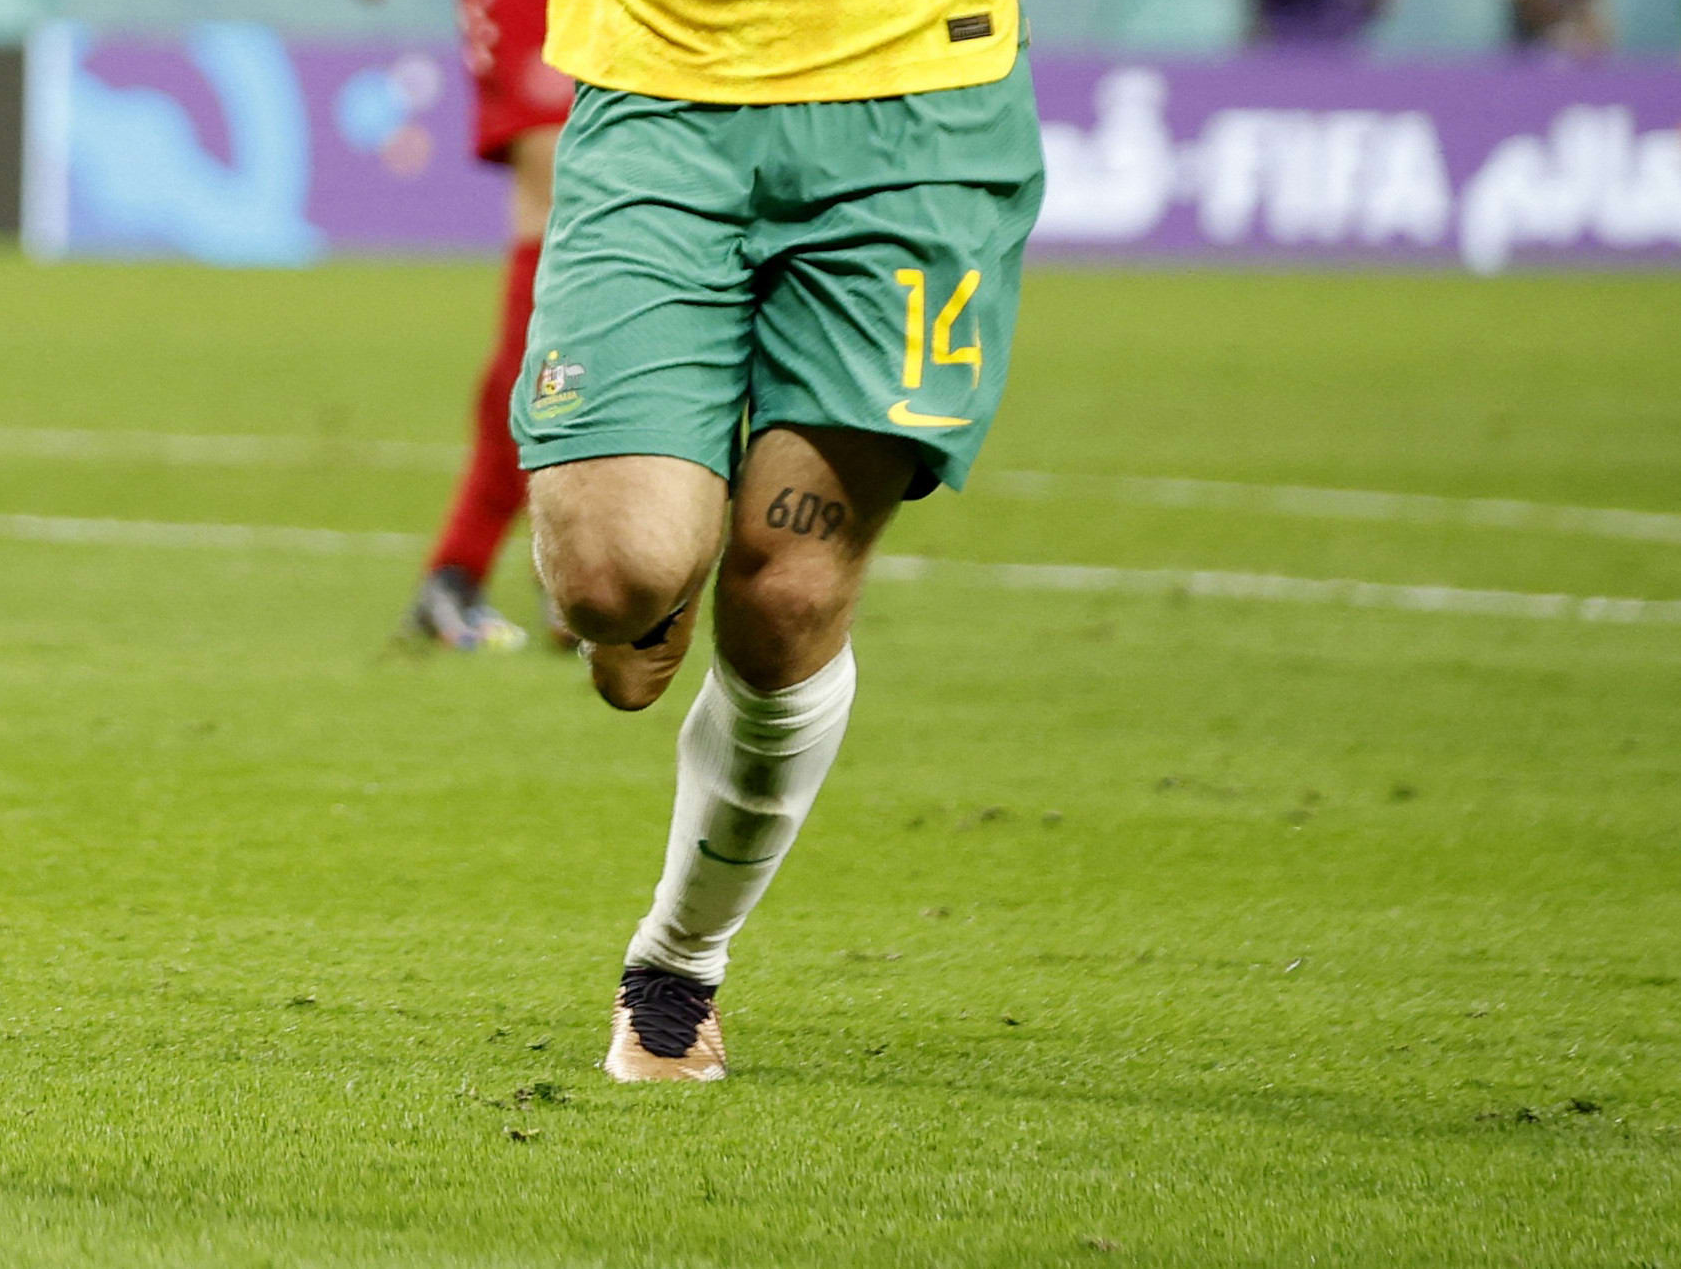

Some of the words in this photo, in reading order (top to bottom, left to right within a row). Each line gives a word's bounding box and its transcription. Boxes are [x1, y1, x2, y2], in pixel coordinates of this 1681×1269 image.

[1201, 107, 1453, 245] FIFA
[895, 269, 982, 389] 14
[766, 487, 846, 542] 609
